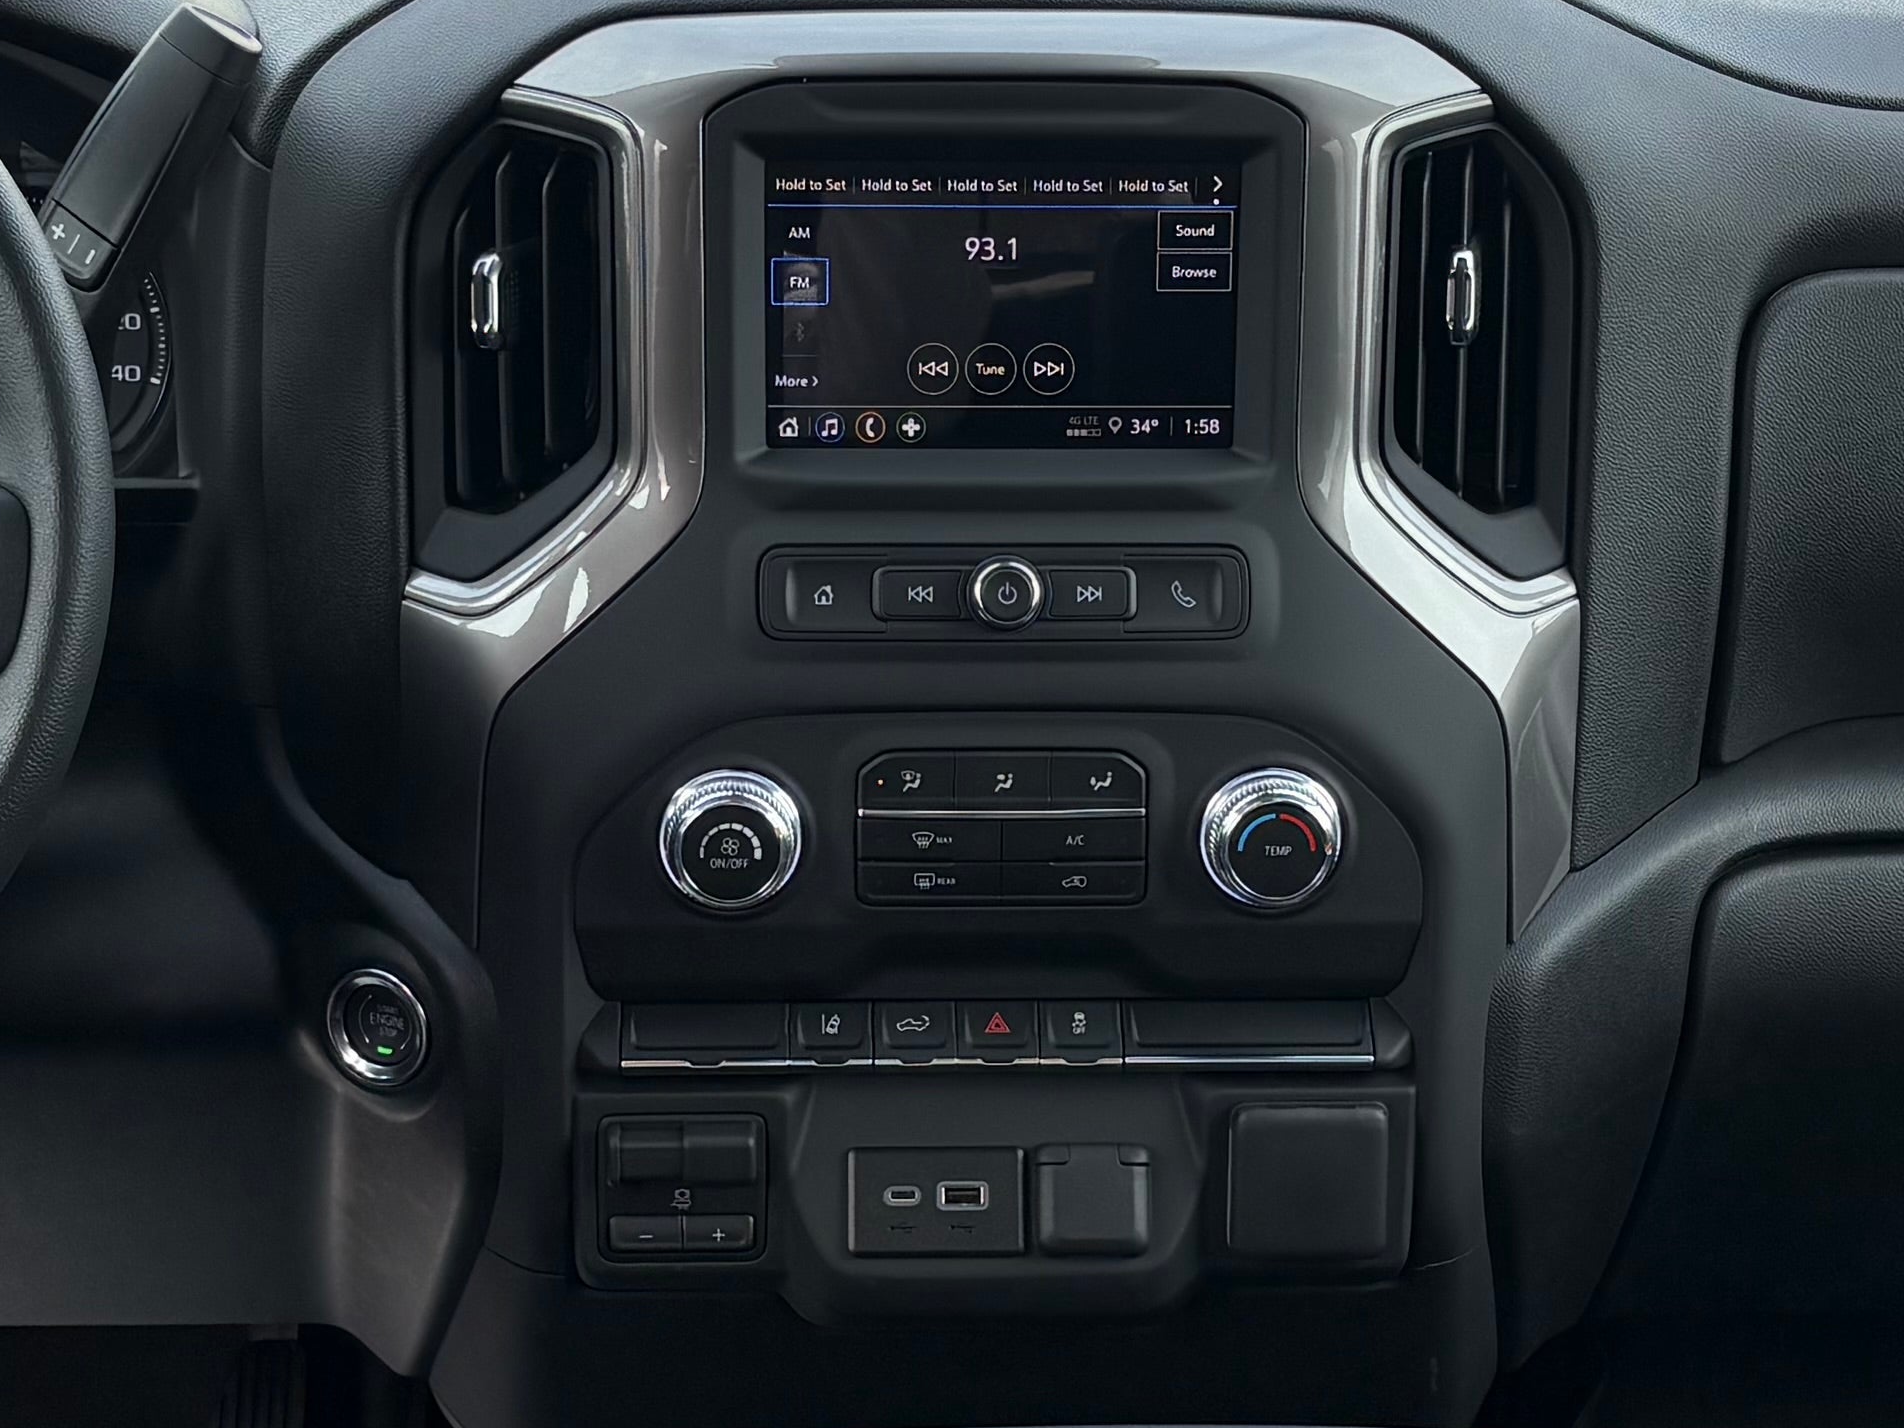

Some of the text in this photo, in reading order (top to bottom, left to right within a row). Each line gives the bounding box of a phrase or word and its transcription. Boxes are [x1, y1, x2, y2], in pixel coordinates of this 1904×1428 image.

[775, 178, 847, 191] Hold to Set
[861, 178, 932, 192] Hold to Set
[947, 179, 1018, 192] Hold to Set
[1033, 179, 1104, 193] Hold to Set
[1118, 179, 1189, 193] Hold to Set
[788, 227, 811, 239] AM
[1175, 224, 1215, 237] Sound
[964, 237, 1017, 261] 93.1
[1172, 265, 1217, 279] Browse
[789, 277, 810, 289] FM
[975, 363, 1005, 376] Tune
[774, 375, 809, 387] More
[1083, 416, 1100, 426] LTE
[1184, 418, 1220, 434] 1:58
[1065, 834, 1085, 847] A/C
[1264, 845, 1293, 857] TEMP
[709, 858, 750, 869] ON/OFF
